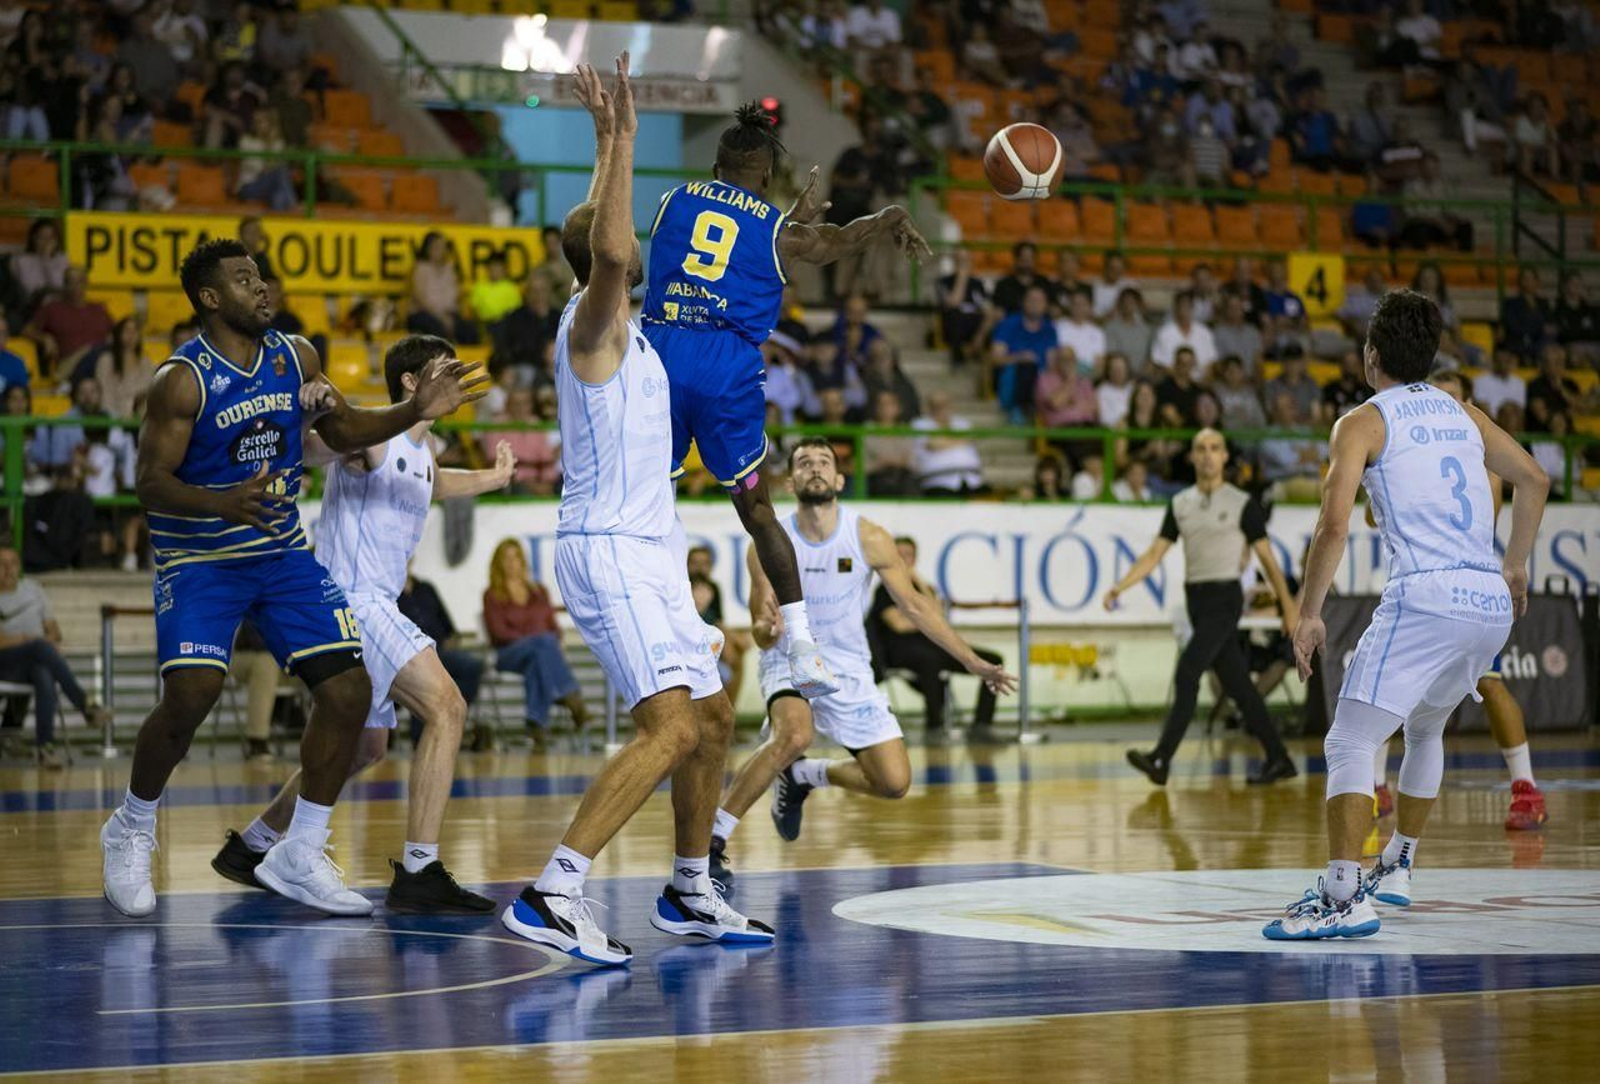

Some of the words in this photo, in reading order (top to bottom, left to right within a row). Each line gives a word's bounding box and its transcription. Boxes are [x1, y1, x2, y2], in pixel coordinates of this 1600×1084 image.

[686, 181, 770, 220] WILLIAMS
[260, 232, 531, 284] OULEARD
[681, 210, 740, 282] 9
[1304, 265, 1328, 307] 4
[215, 393, 293, 429] OURENSE
[1440, 456, 1473, 531] 3
